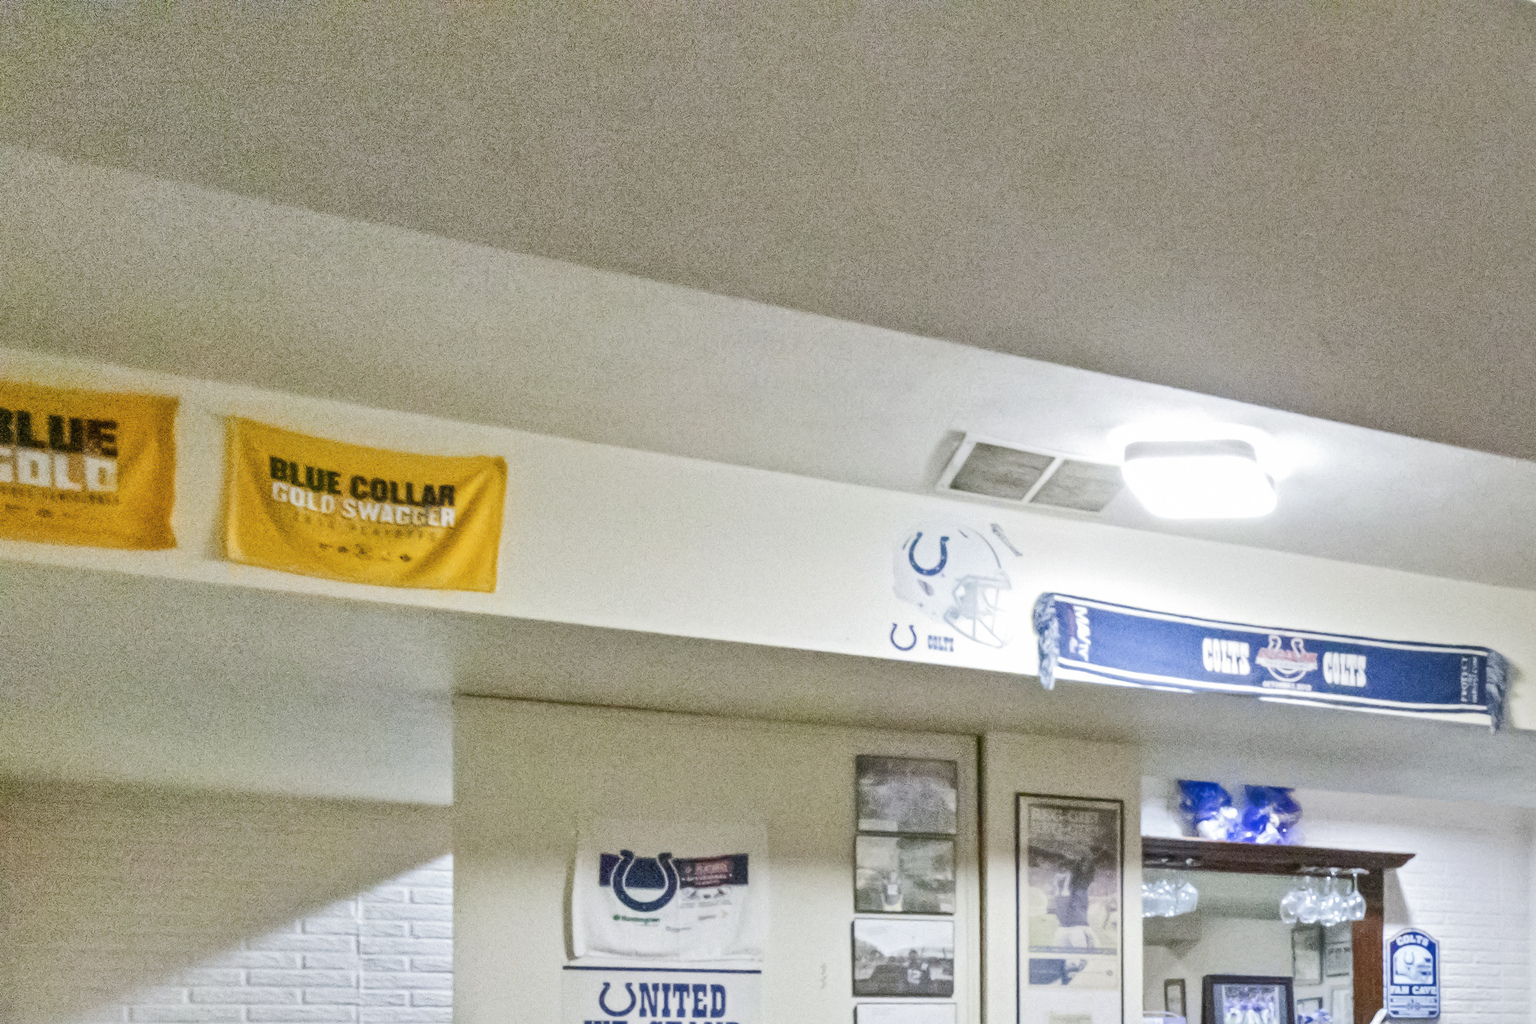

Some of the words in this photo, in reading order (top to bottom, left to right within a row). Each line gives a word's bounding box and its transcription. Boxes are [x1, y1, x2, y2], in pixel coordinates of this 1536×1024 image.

[269, 456, 341, 494] BLUE
[350, 474, 455, 507] COLLAR
[272, 481, 334, 514] GOLD
[342, 498, 455, 527] SWAGGER
[1202, 637, 1250, 675] COLTS
[1323, 651, 1367, 687] COLTS
[1395, 934, 1429, 947] COLTS
